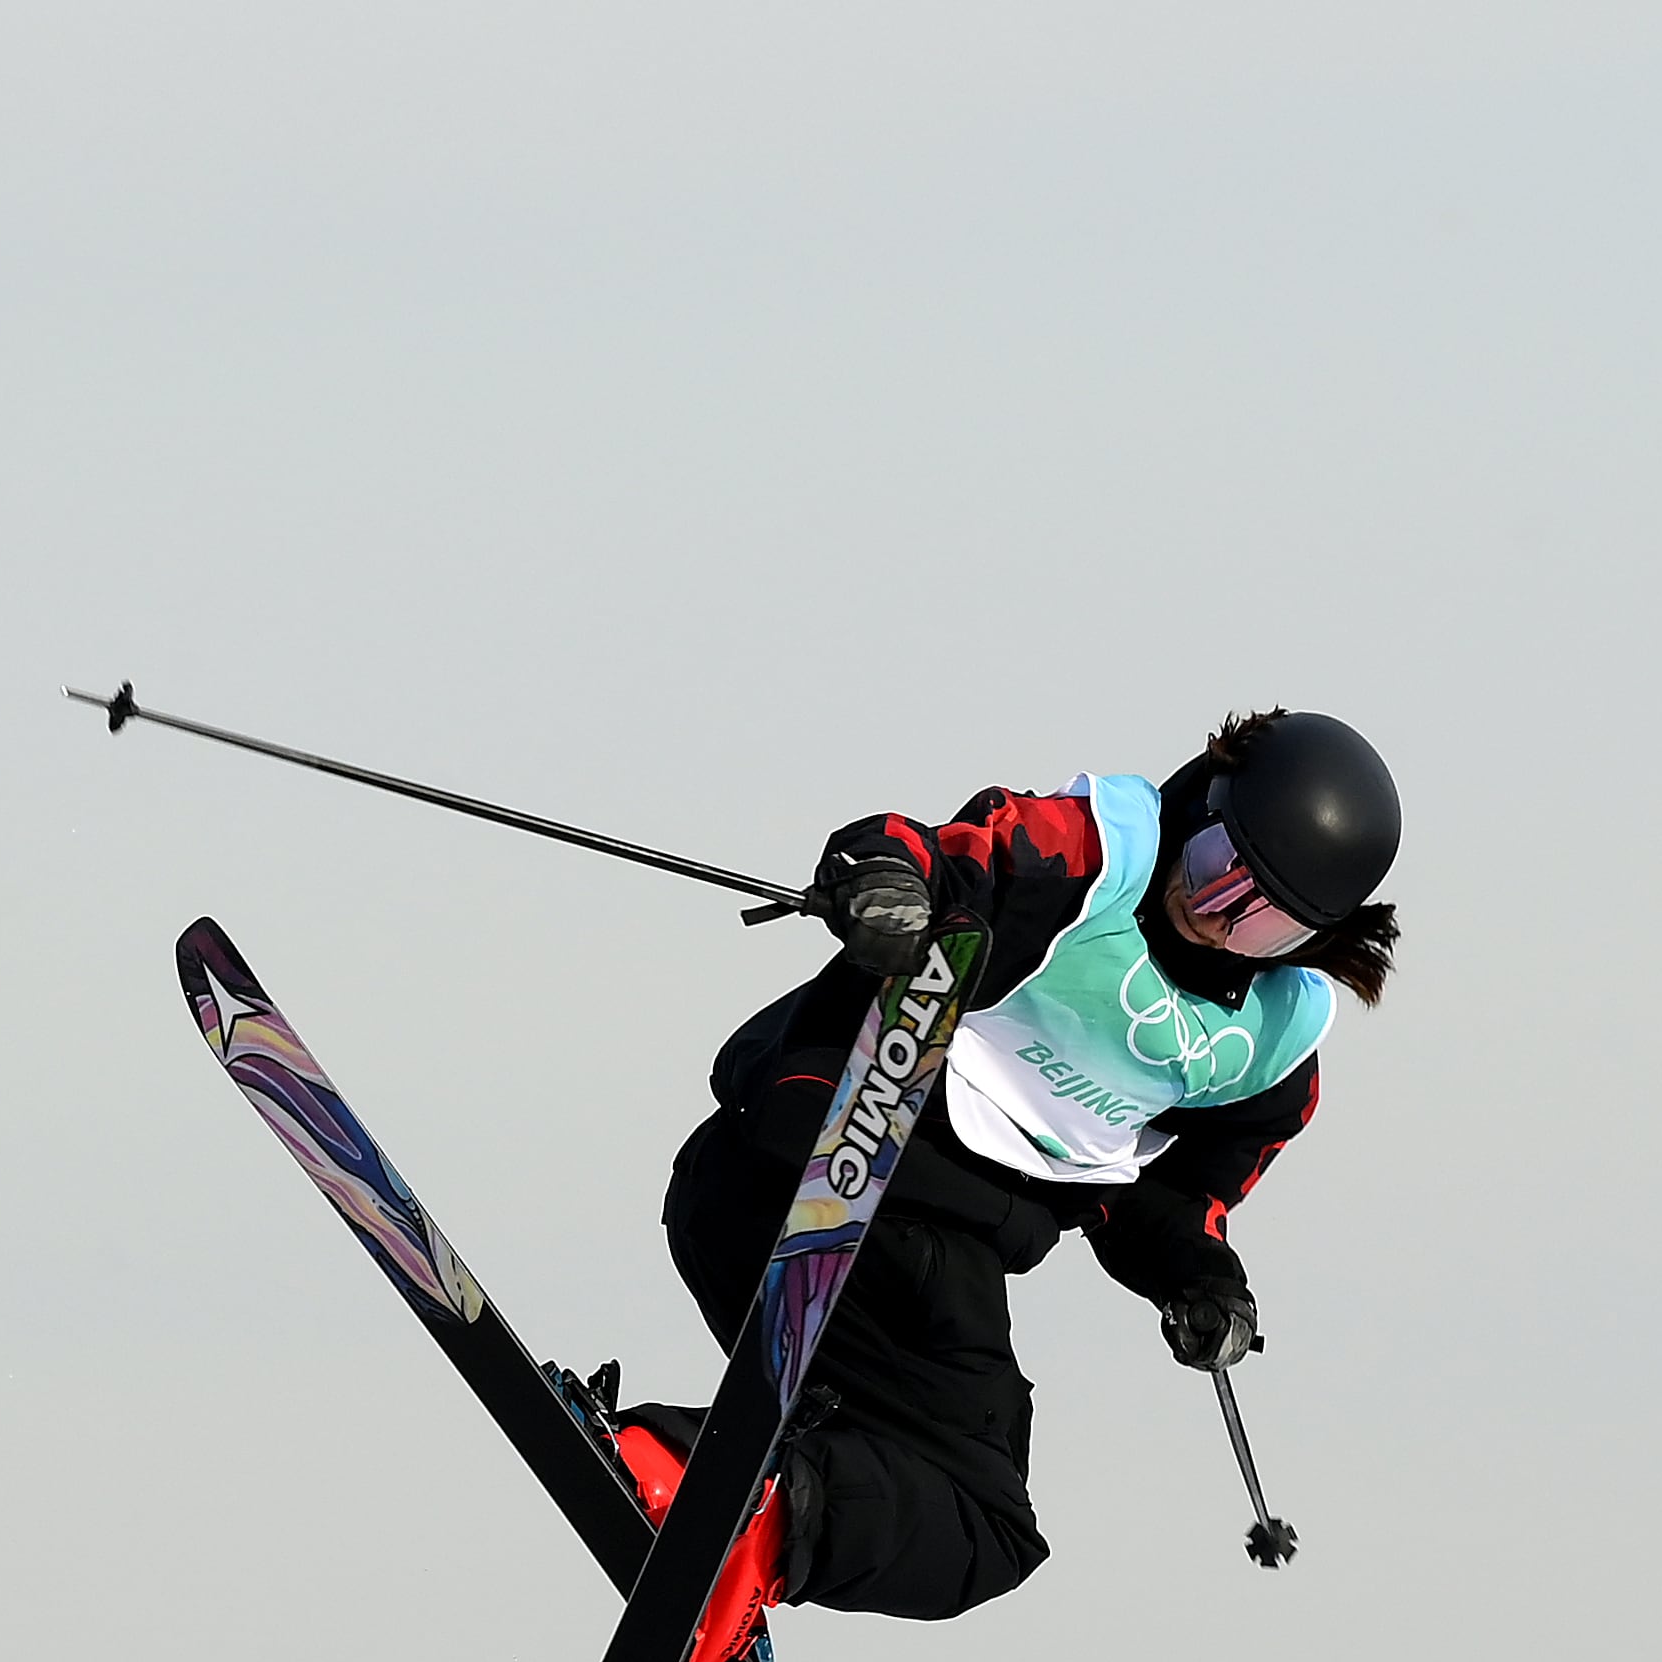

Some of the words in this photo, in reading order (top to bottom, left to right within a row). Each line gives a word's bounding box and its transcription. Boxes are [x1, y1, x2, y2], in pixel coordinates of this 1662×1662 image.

[829, 941, 955, 1197] ATOMIC
[1014, 1040, 1139, 1127] BEIJING
[720, 1586, 762, 1657] ATOMIC
